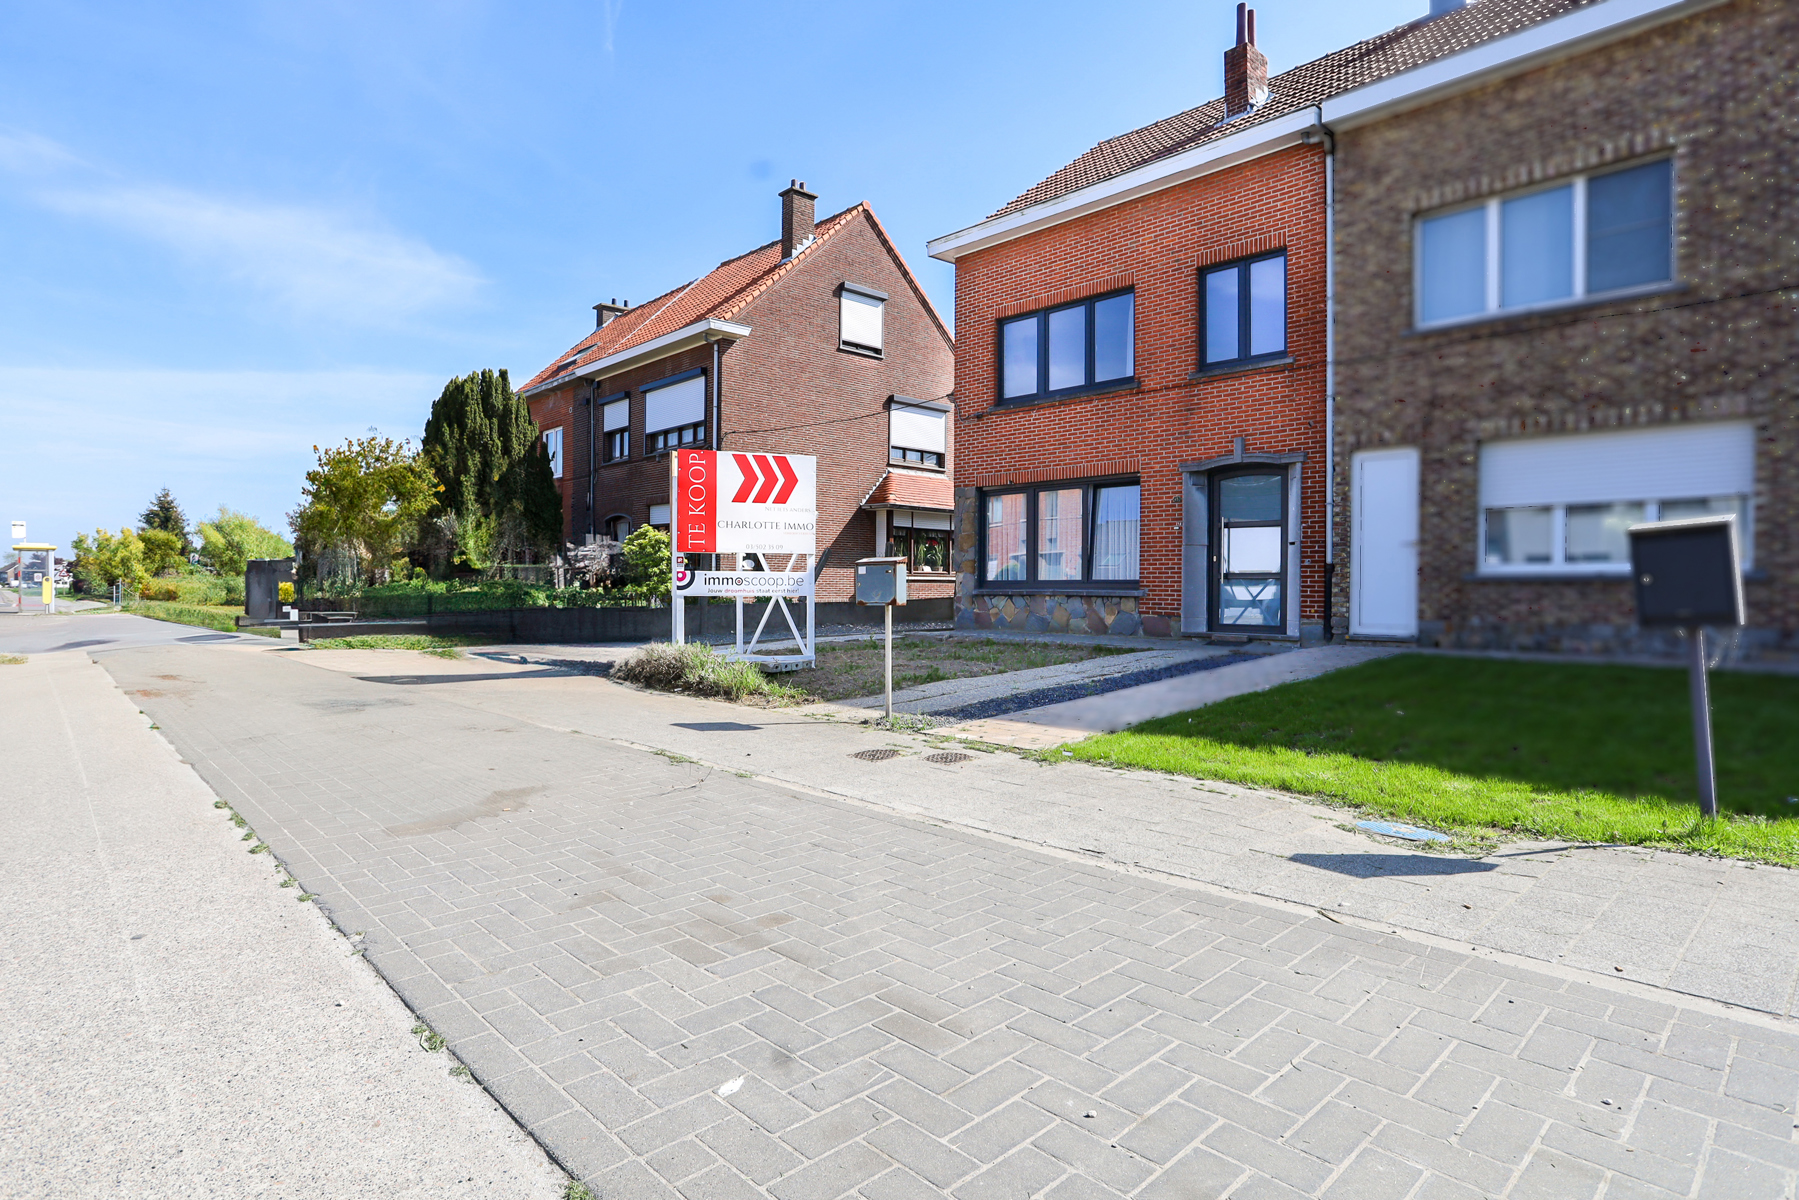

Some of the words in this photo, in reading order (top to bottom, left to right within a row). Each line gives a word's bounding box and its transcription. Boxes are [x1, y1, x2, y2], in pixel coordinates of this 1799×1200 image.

[688, 453, 707, 516] KOOP
[688, 522, 706, 549] TE
[717, 520, 781, 530] CHARLOTTE
[784, 522, 815, 530] IMMO
[704, 573, 804, 588] immoscoop.be
